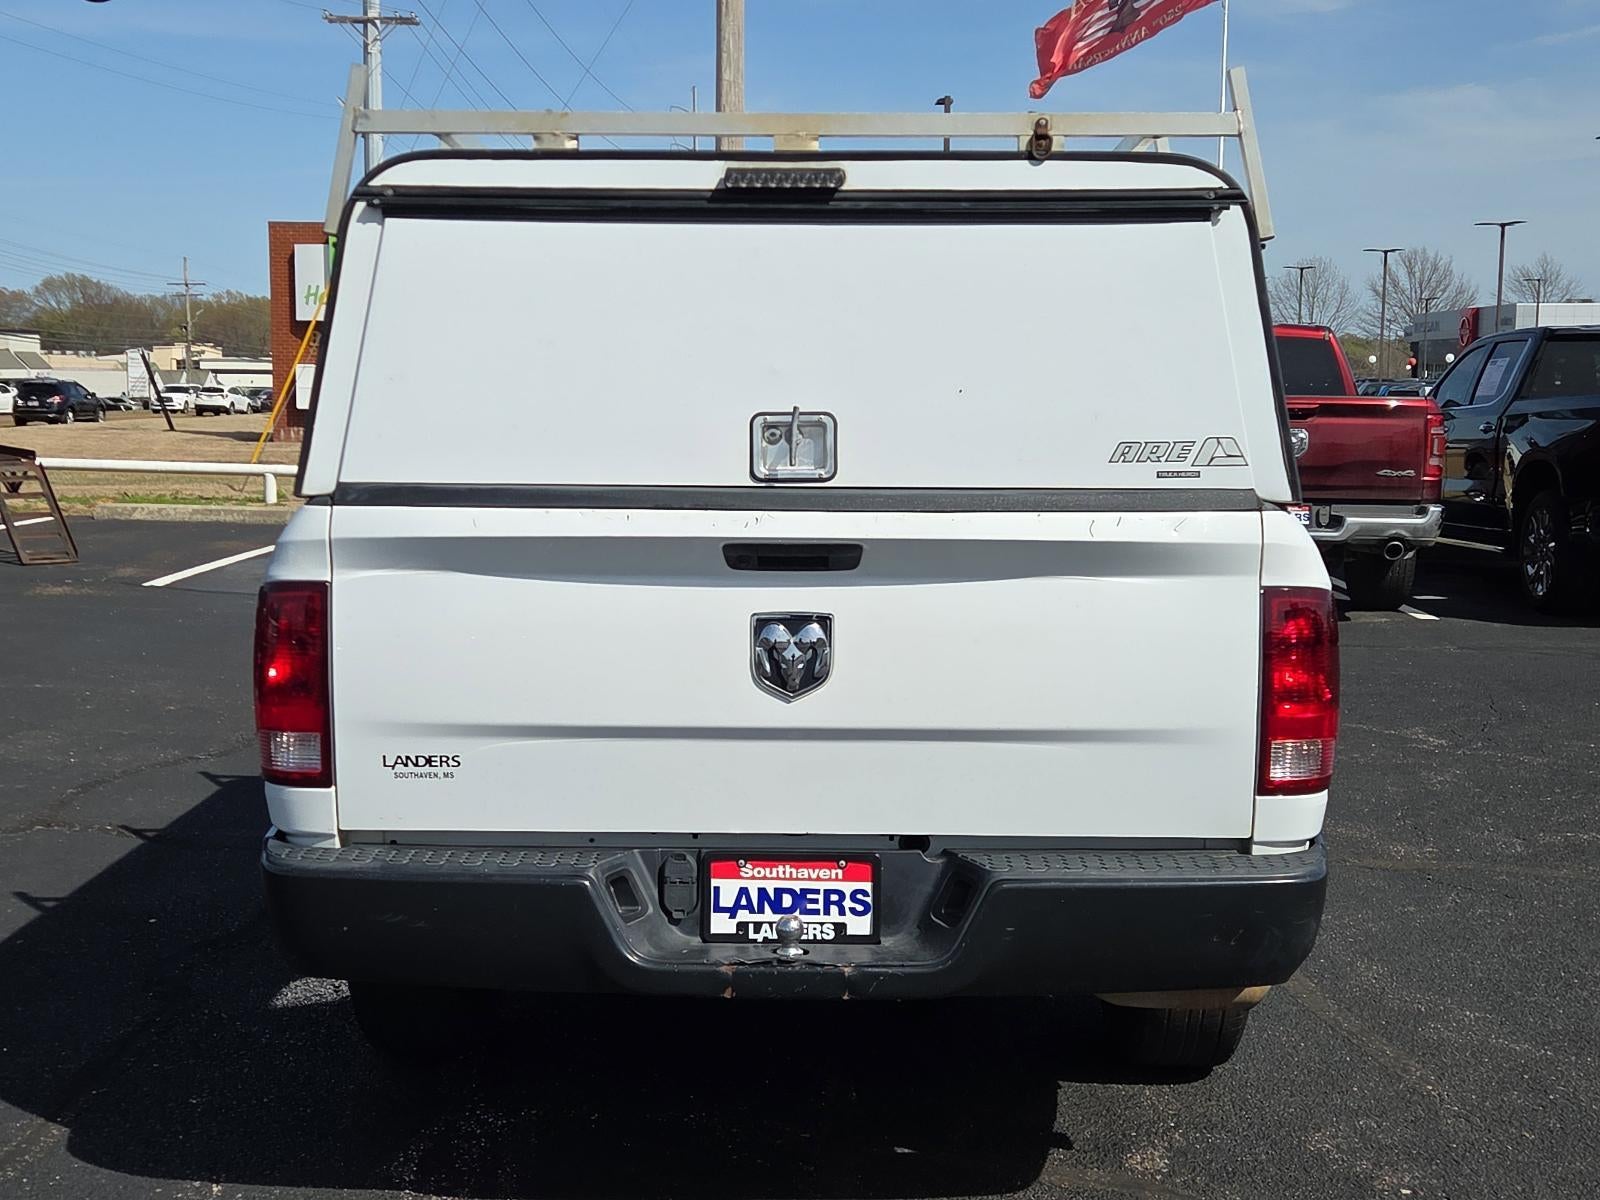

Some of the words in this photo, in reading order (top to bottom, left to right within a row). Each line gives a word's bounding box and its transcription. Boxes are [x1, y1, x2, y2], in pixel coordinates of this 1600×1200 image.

[1108, 441, 1196, 463] ARE
[382, 754, 461, 771] LANDERS
[393, 771, 441, 780] SOUTHAVEN,
[442, 771, 455, 779] MS
[739, 863, 843, 879] Southaven
[712, 885, 872, 919] LANDERS
[748, 923, 836, 942] LAERS
